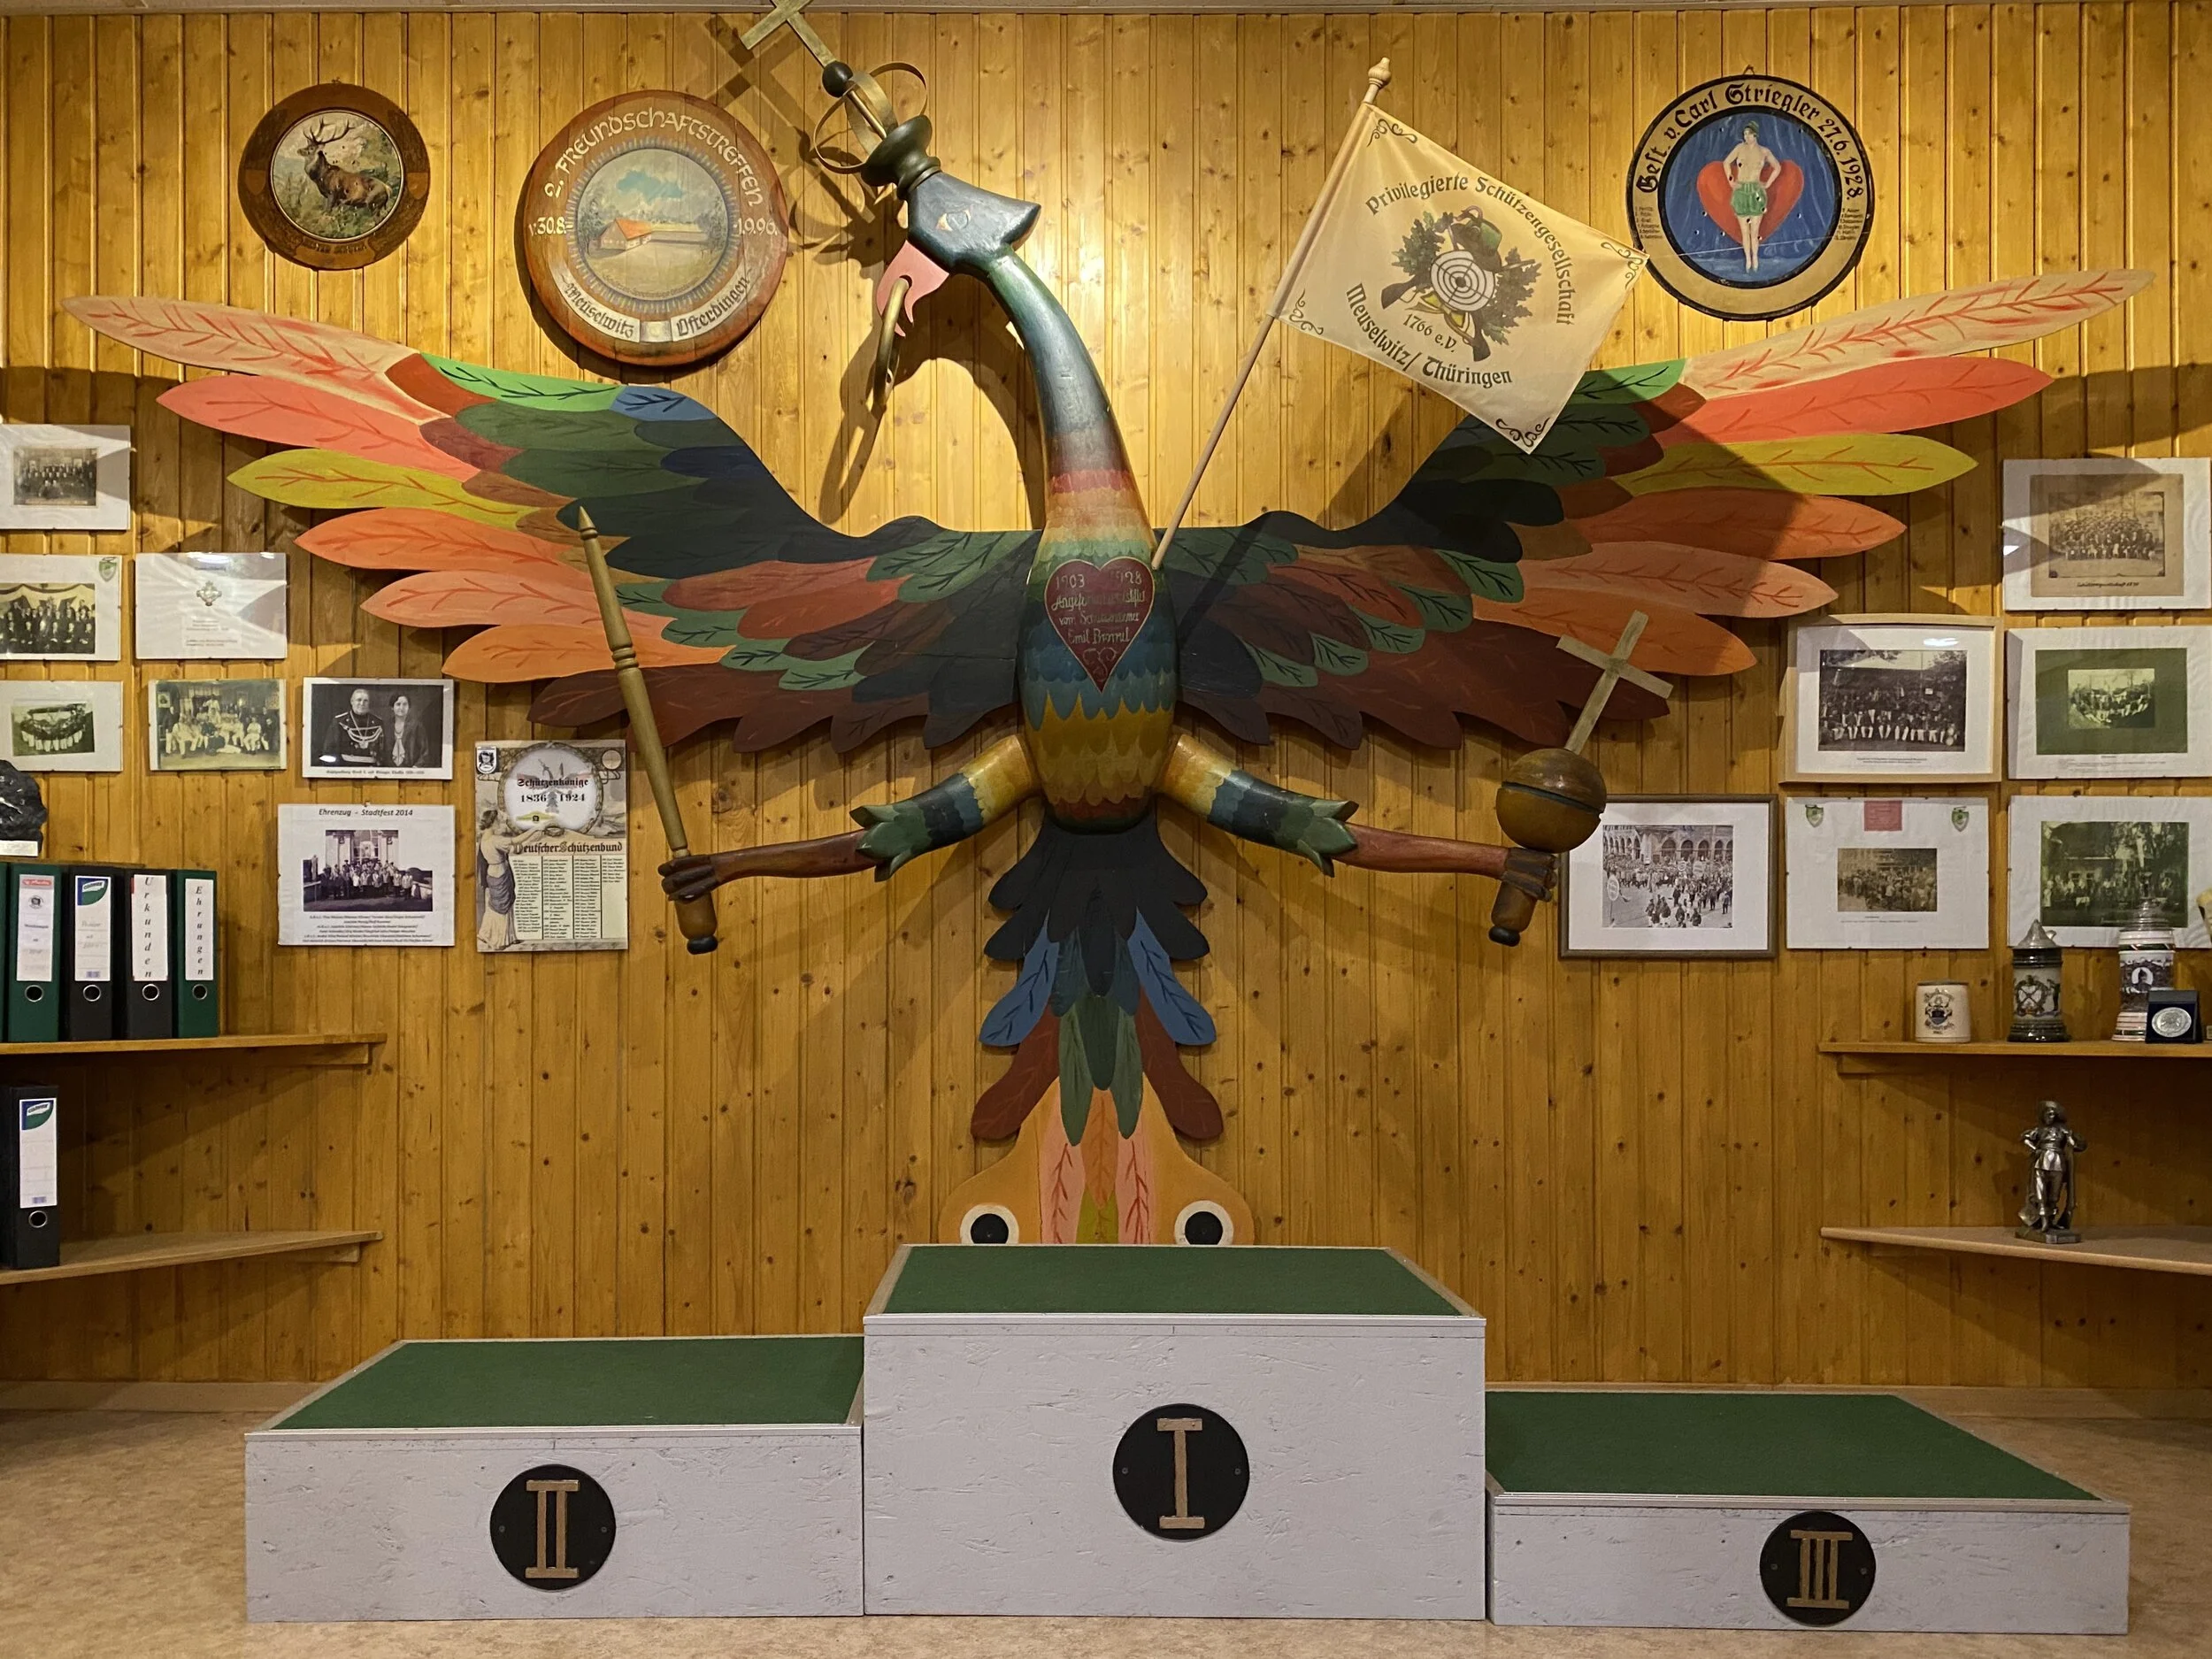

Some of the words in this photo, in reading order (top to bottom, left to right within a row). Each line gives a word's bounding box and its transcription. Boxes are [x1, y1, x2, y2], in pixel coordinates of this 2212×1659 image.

[1725, 82, 1821, 121] Striegler
[1365, 174, 1469, 215] Privilegierte
[1475, 176, 1576, 326] Schützengesellschaft
[676, 276, 750, 337] Ofterdingen
[1402, 313, 1432, 337] 1766
[1422, 356, 1513, 389] Thüringen
[517, 778, 589, 788] Schützenkönige
[520, 794, 547, 803] 1836
[559, 793, 586, 802] 1924
[319, 808, 352, 817] Ehrenzug
[361, 809, 394, 818] Stadtfest
[560, 841, 623, 855] Schützenbund
[143, 877, 154, 979] Urkunden
[195, 886, 204, 975] Ehrungen
[525, 1479, 580, 1578] II
[1786, 1529, 1854, 1609] III
